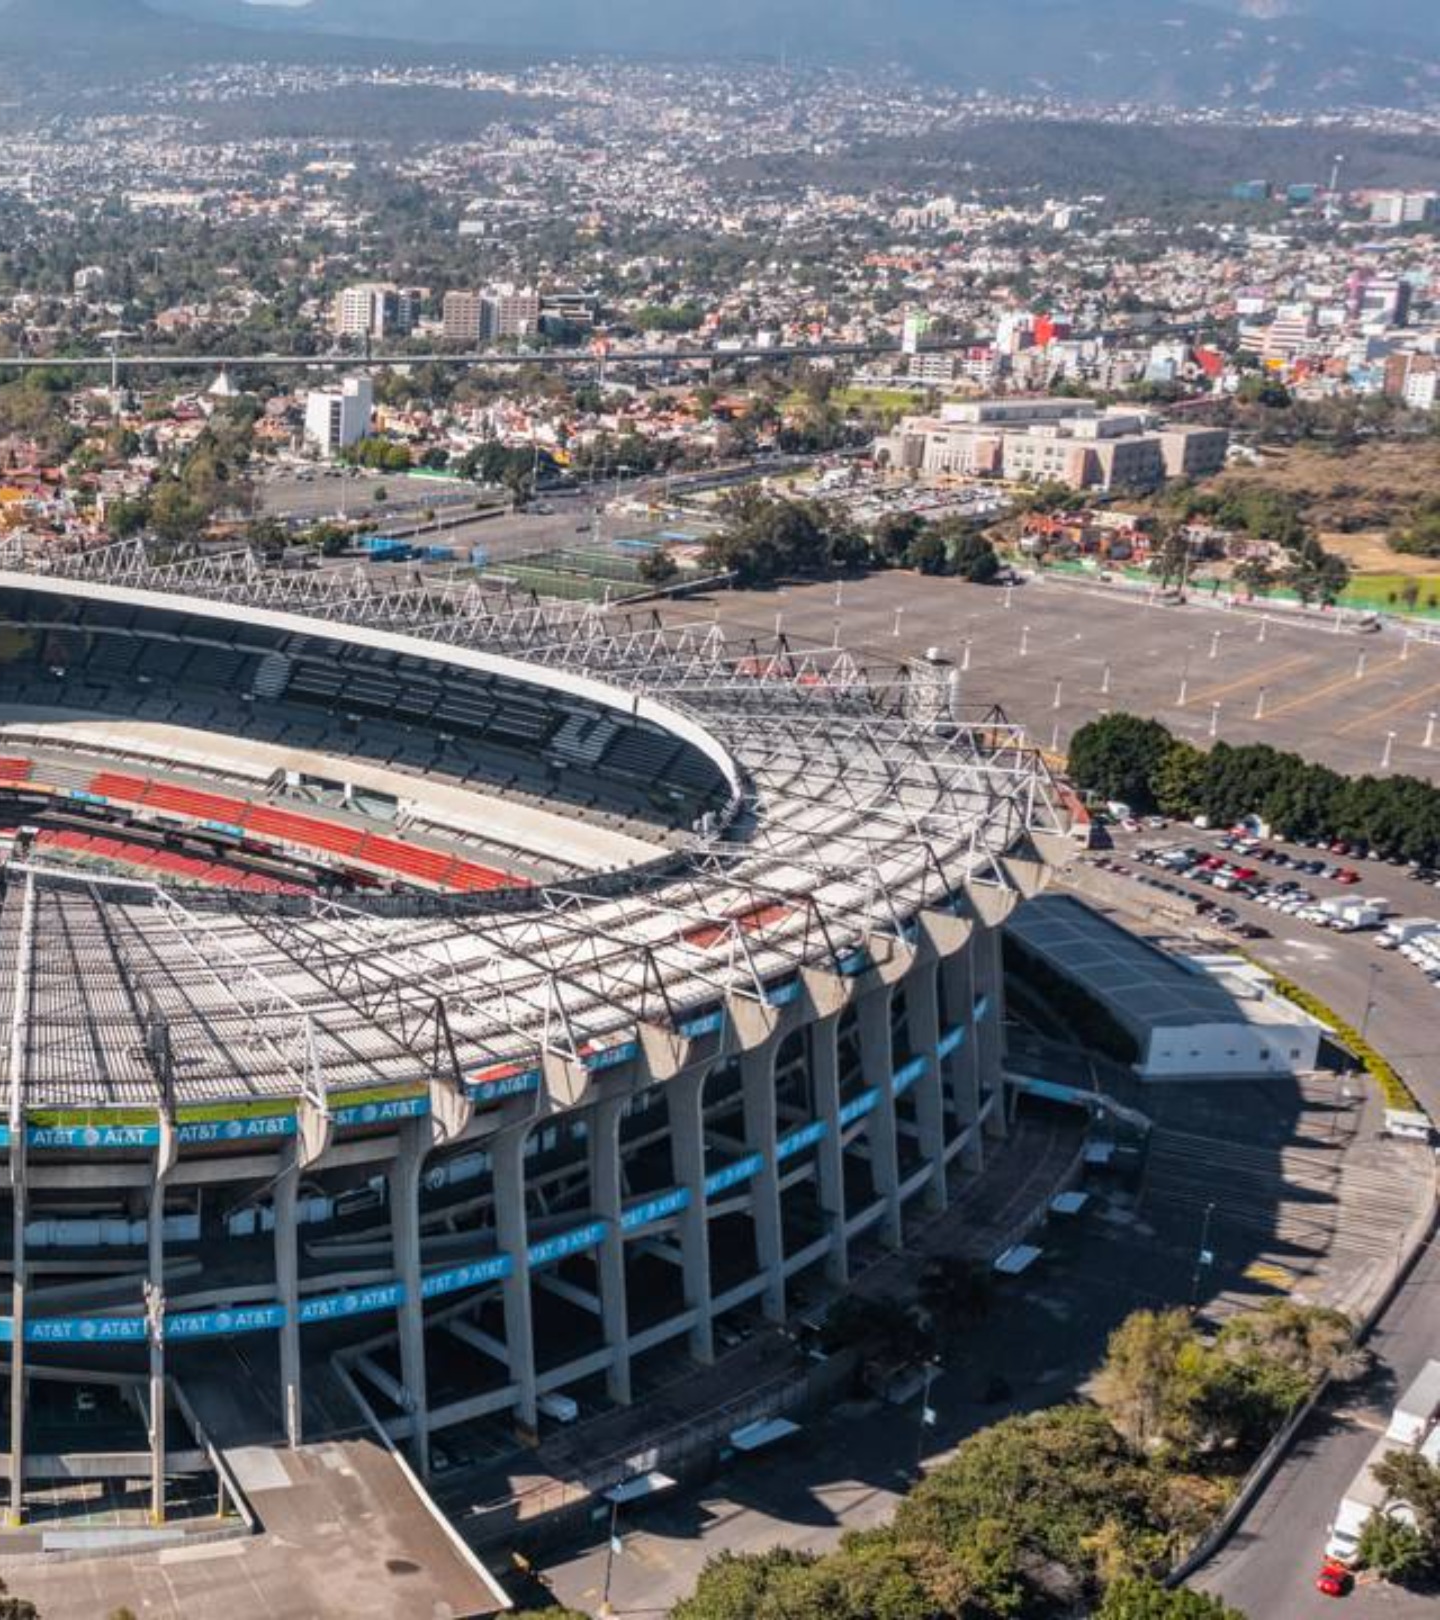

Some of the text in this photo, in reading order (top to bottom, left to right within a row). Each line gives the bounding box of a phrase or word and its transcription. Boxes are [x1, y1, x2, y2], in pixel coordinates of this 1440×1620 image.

[379, 1101, 417, 1118] AT&T
[33, 1127, 148, 1145] AT&T AT&T
[178, 1117, 289, 1142] AT&T AT&T
[471, 1259, 505, 1280] AT&T
[302, 1288, 397, 1318] AT&T AT&T
[32, 1322, 141, 1338] AT&T AT&T
[169, 1309, 274, 1334] AT&T AT&T
